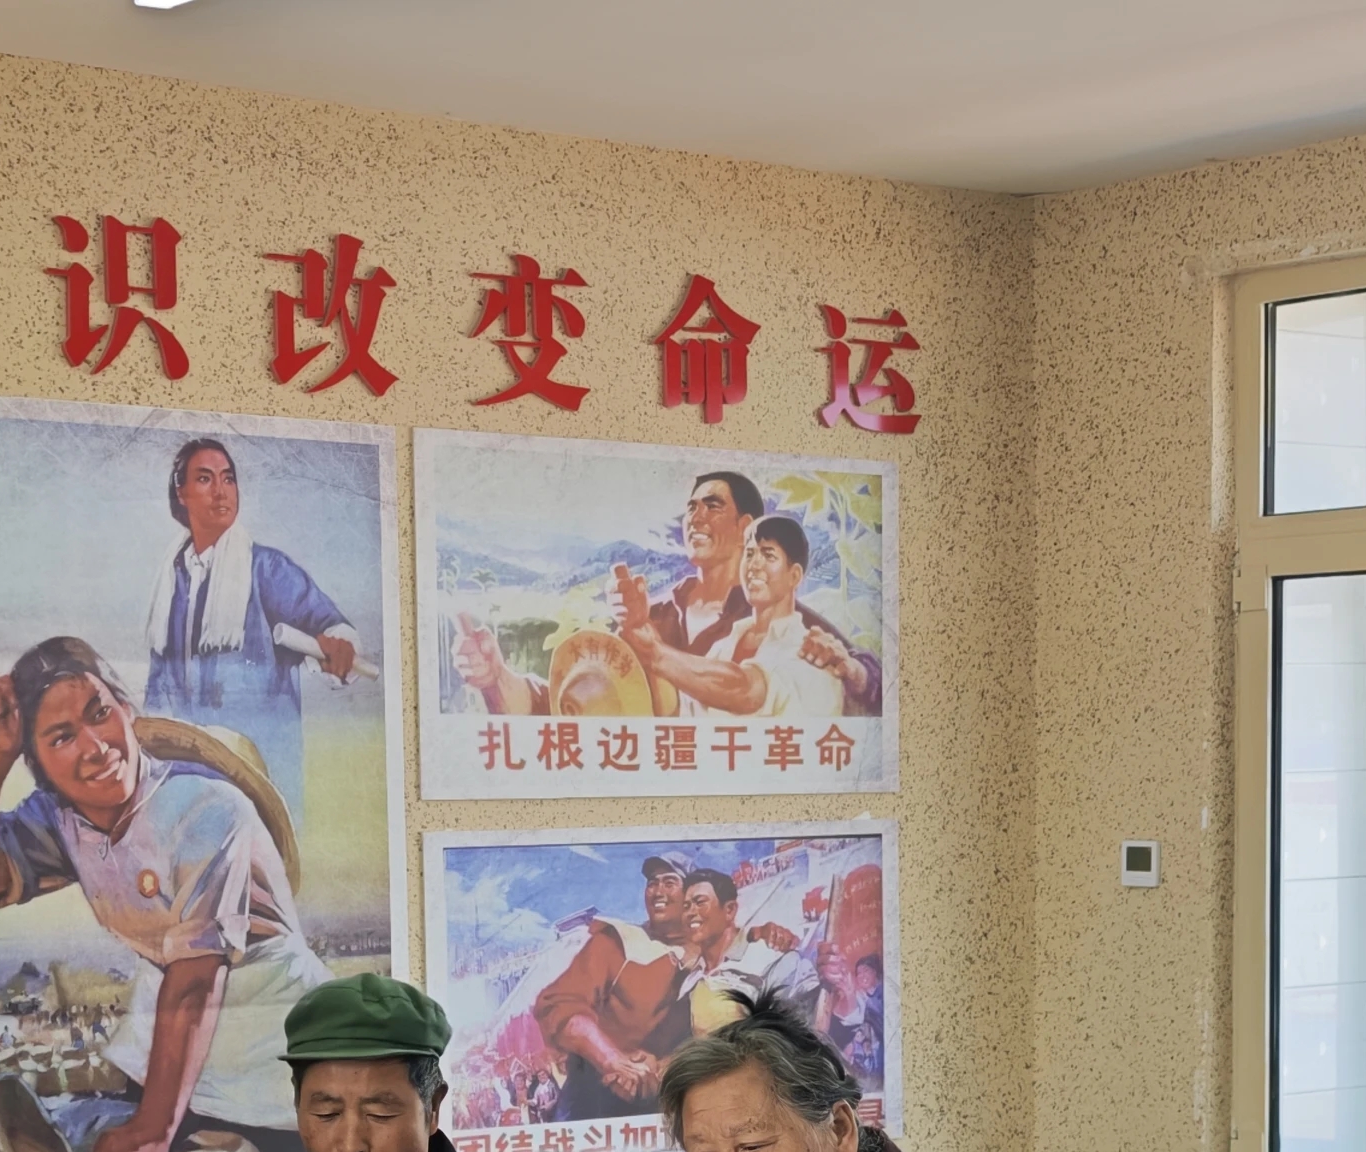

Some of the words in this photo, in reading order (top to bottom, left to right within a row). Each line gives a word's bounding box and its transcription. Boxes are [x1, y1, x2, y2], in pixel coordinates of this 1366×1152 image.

[477, 721, 856, 772] 扎根边疆干革命
